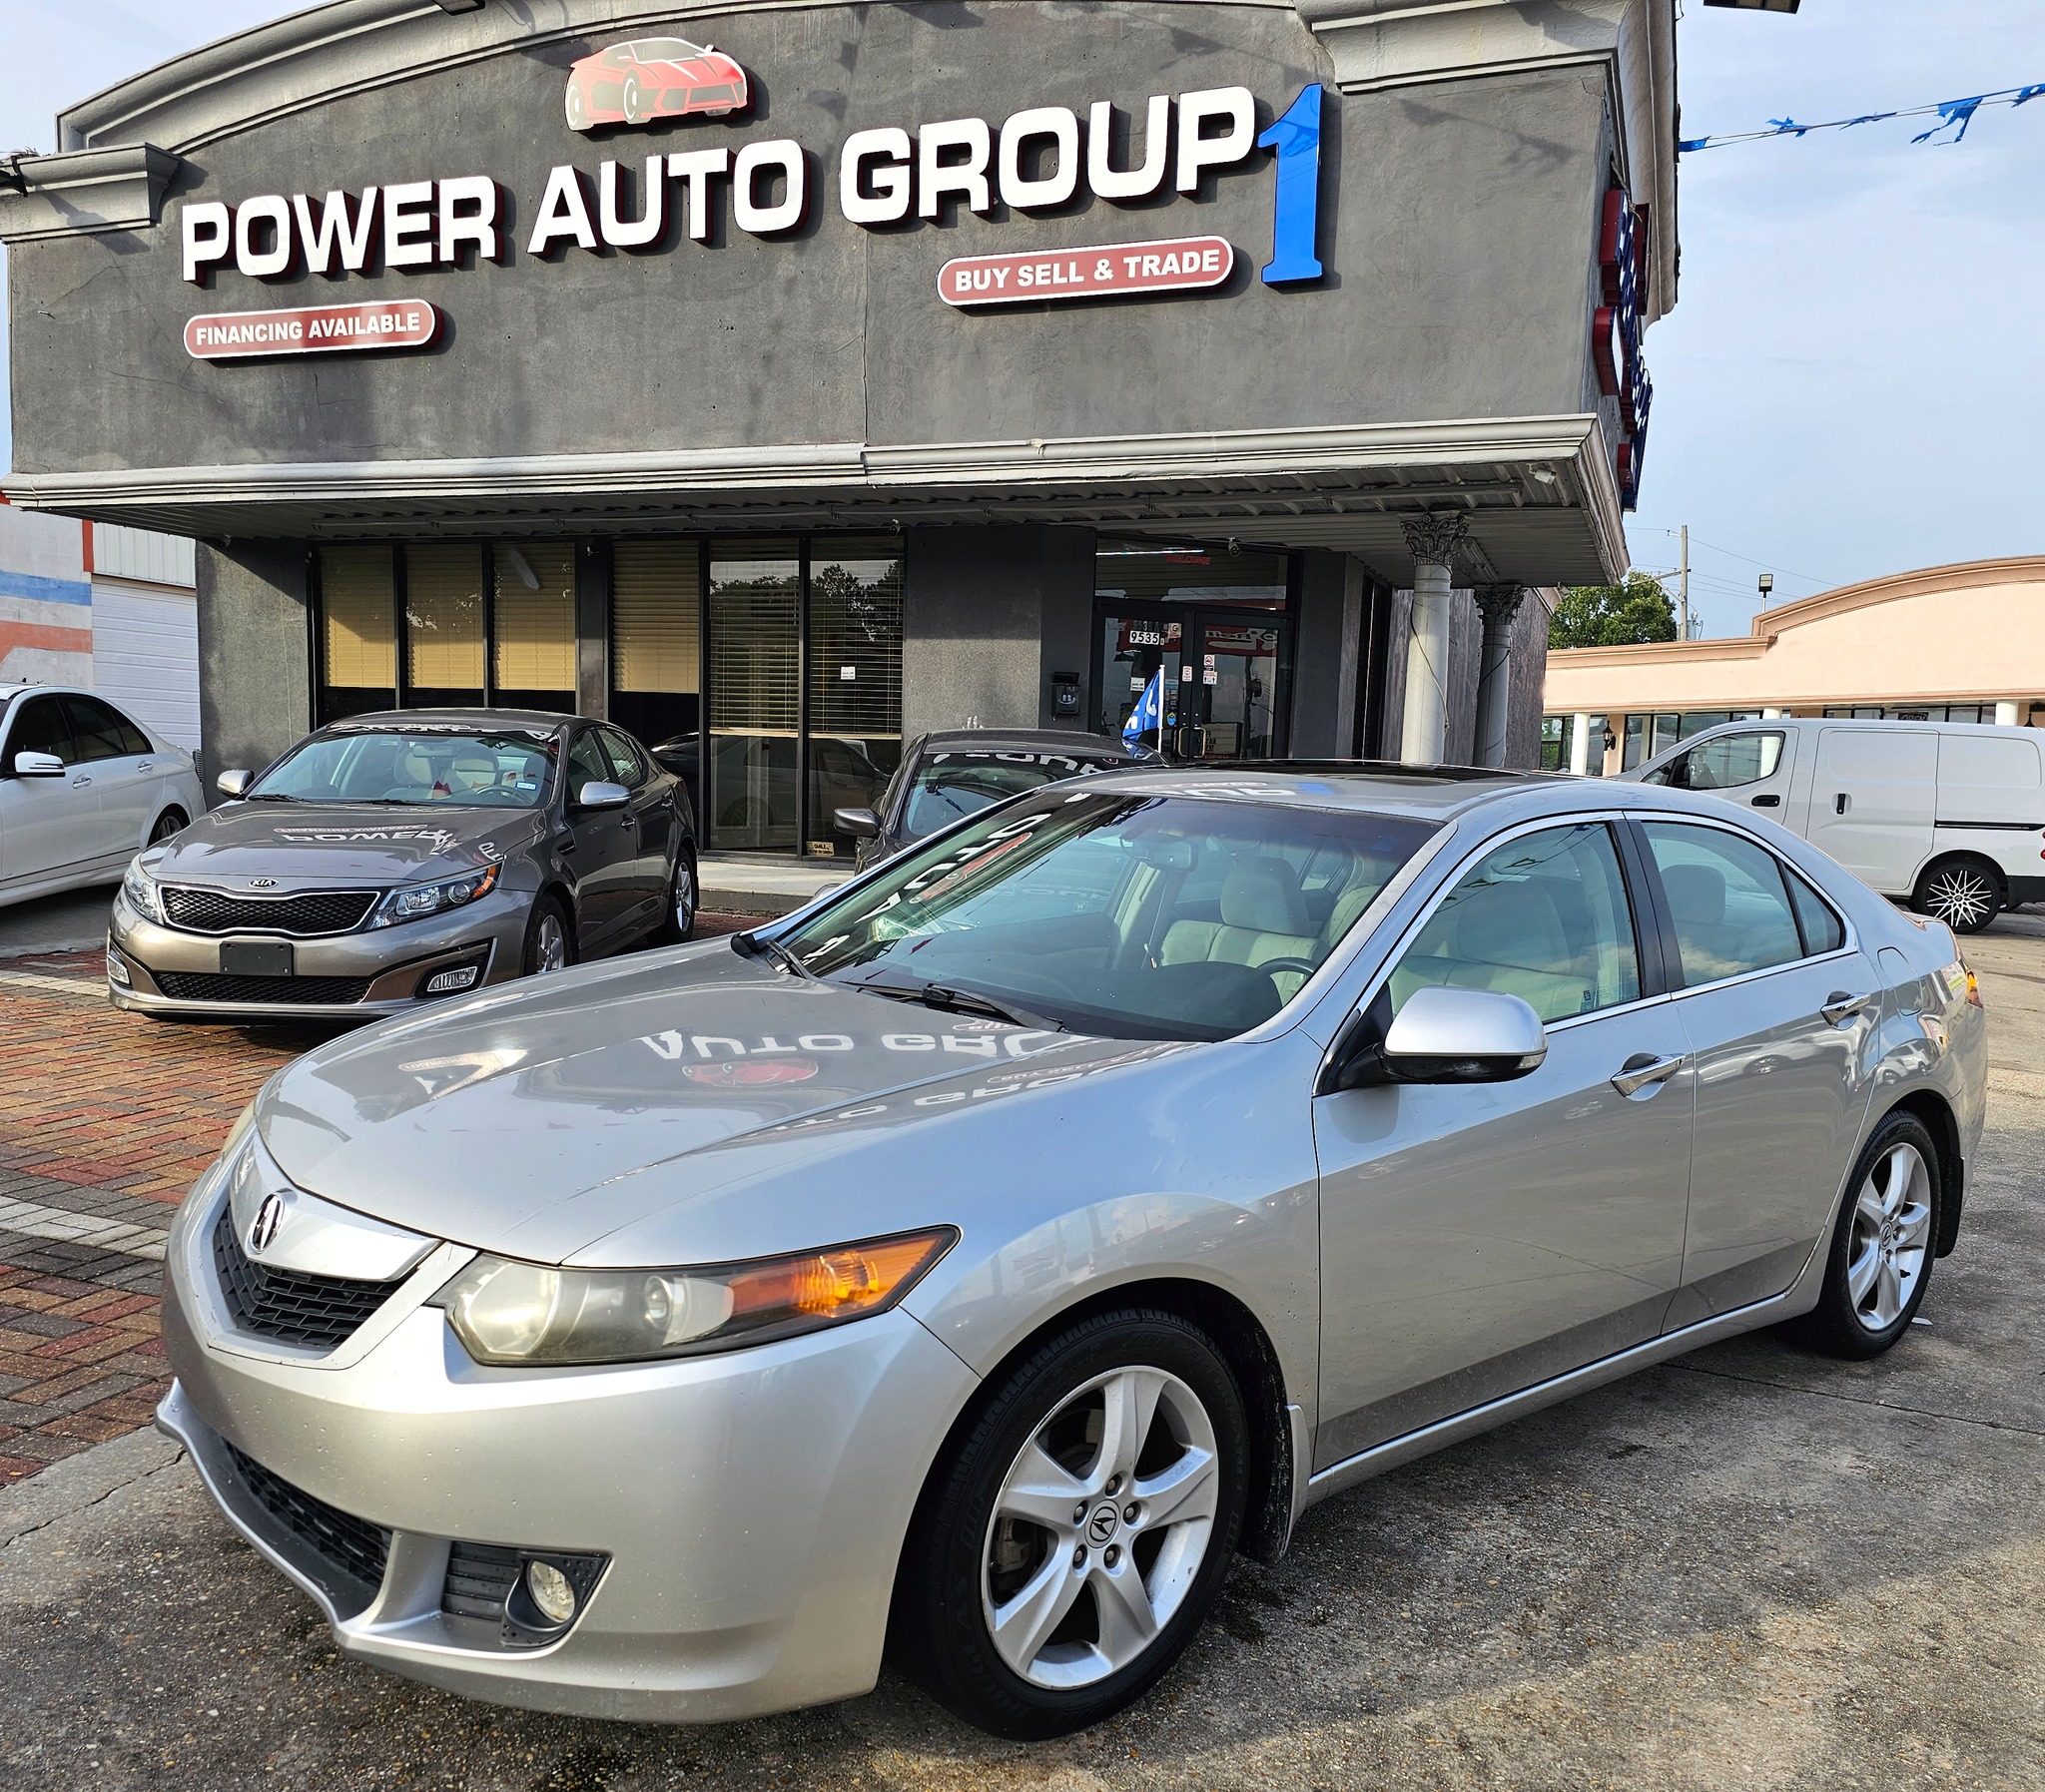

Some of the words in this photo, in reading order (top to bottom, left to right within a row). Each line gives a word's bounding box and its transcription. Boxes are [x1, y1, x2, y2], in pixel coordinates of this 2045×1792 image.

[183, 177, 495, 282] POWER
[527, 139, 805, 254] AUTO
[841, 86, 1256, 223] GROUP
[1257, 82, 1323, 283] 1
[955, 268, 1012, 293] BUY
[1018, 262, 1084, 288] SELL
[1094, 259, 1114, 281] &
[1123, 249, 1220, 279] TRADE
[196, 320, 304, 346] FINANCING
[308, 311, 420, 338] AVAILABLE
[1130, 631, 1159, 644] 9535
